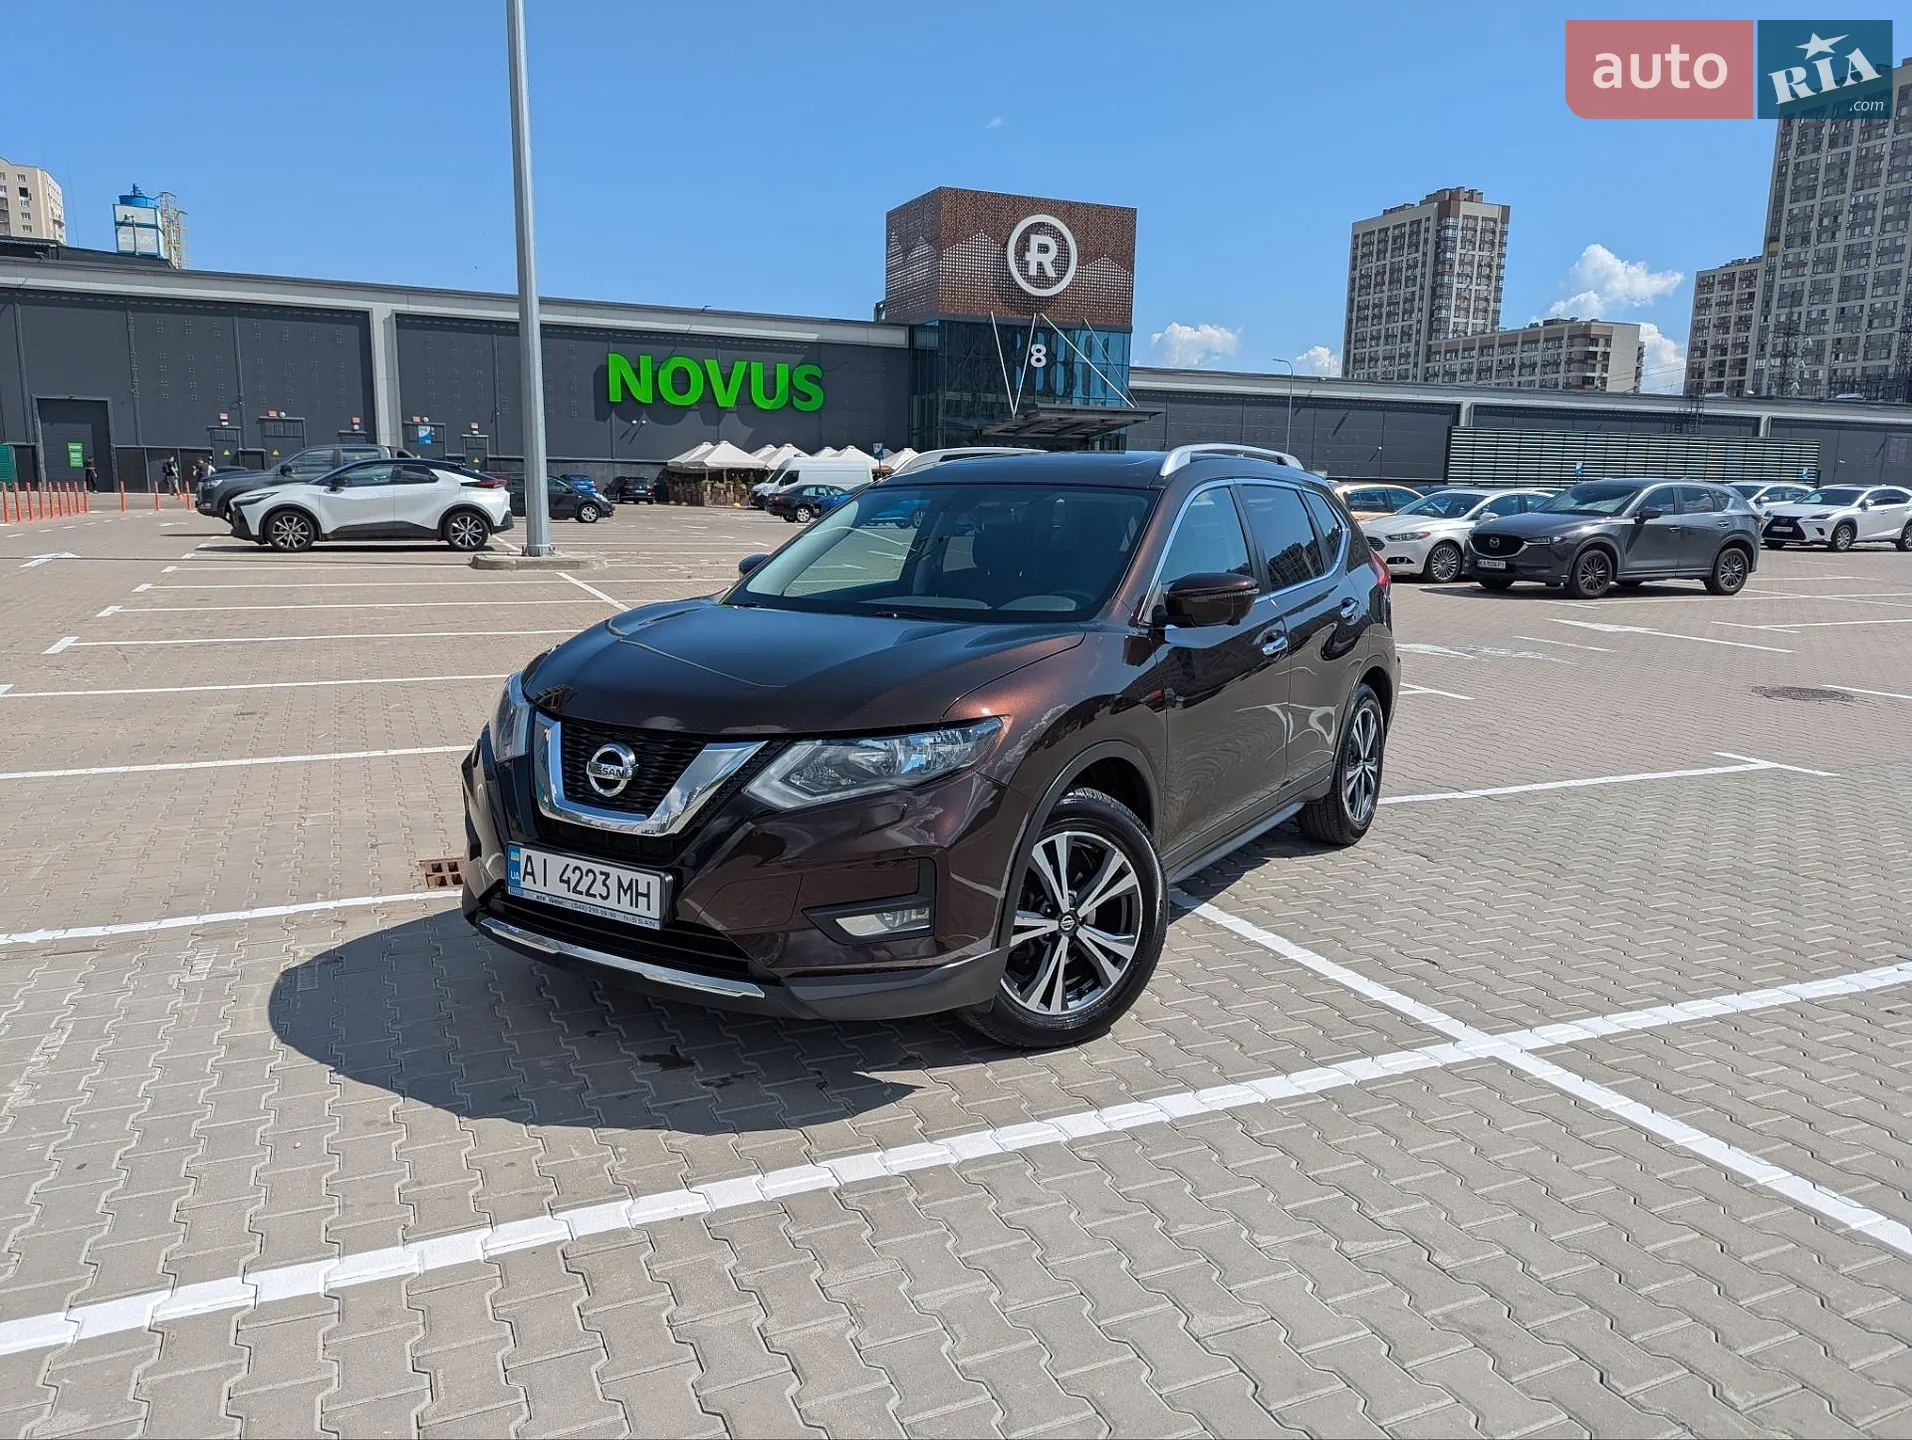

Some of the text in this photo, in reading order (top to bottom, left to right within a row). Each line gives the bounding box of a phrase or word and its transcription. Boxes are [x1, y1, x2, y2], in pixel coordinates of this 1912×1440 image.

[1030, 343, 1047, 368] 8
[607, 352, 825, 412] NOVUS
[510, 870, 520, 881] UA
[522, 854, 651, 912] AI 4223 MH
